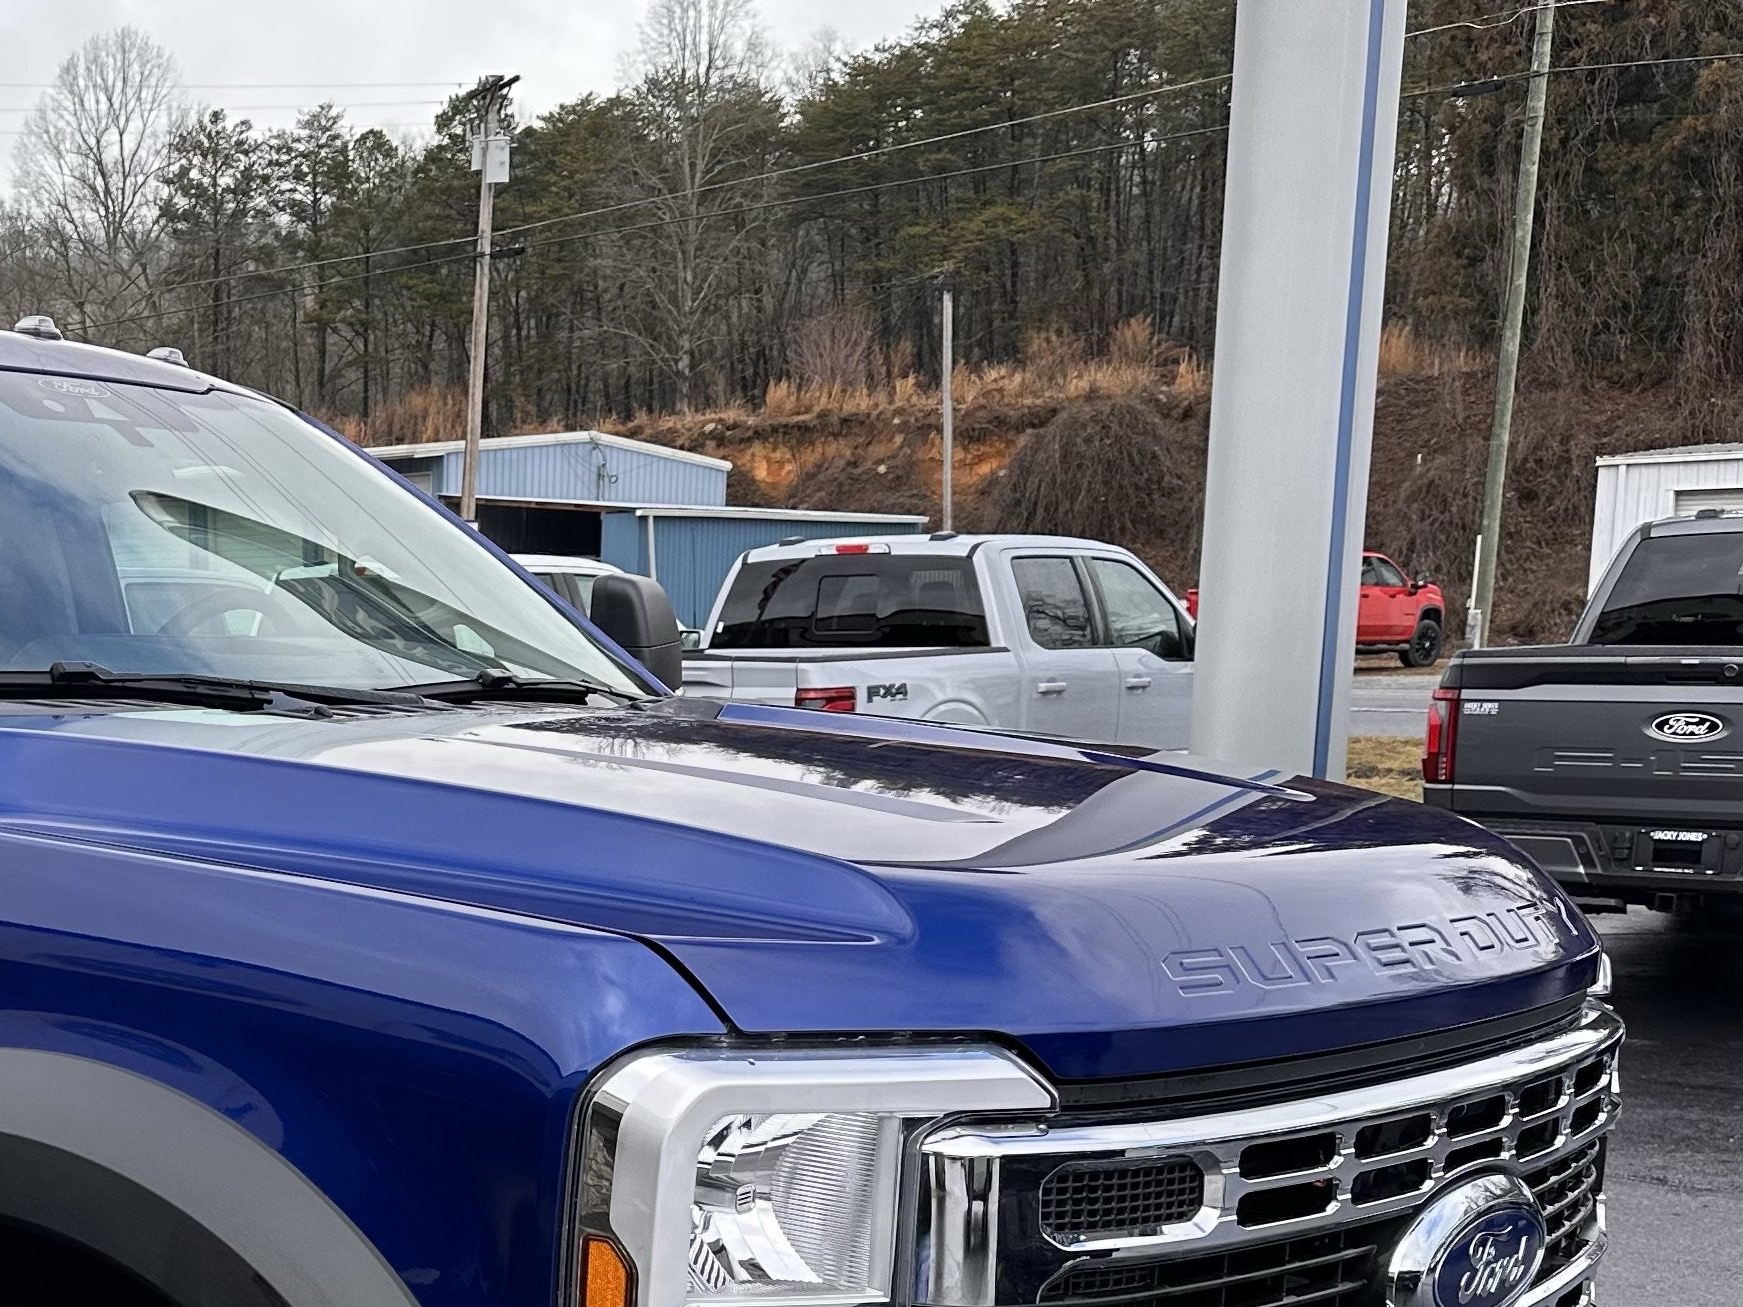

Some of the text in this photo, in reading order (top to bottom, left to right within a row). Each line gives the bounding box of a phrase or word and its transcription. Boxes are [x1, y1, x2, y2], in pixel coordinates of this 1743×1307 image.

[867, 683, 908, 703] FX4
[1663, 716, 1711, 735] Ford
[1160, 922, 1464, 998] SUPER
[1459, 1225, 1528, 1305] Ford
